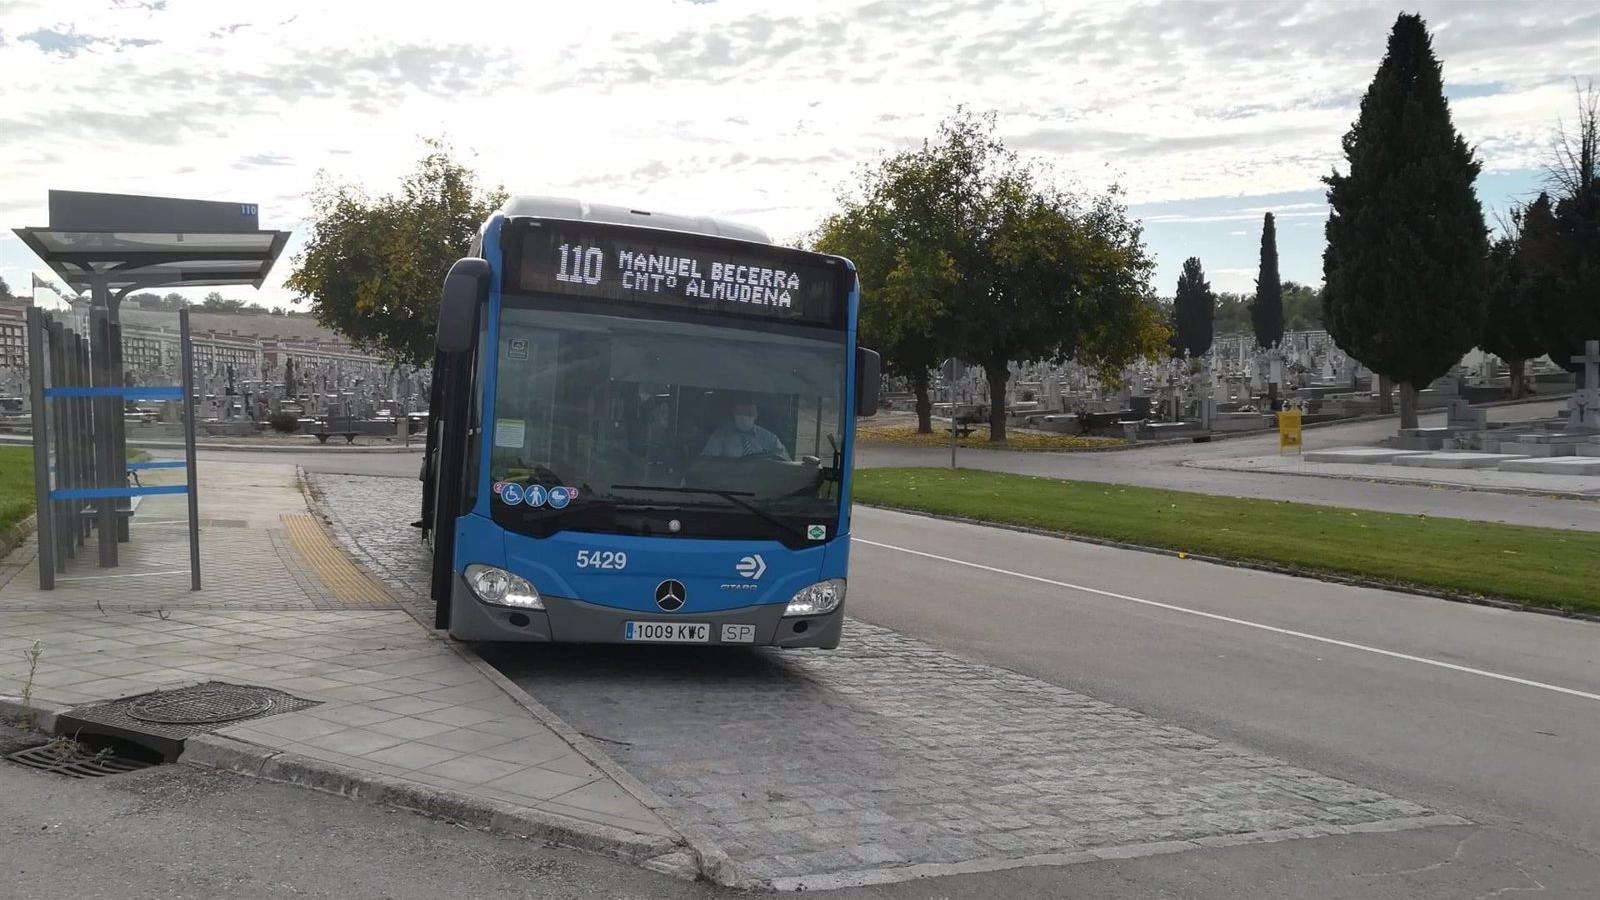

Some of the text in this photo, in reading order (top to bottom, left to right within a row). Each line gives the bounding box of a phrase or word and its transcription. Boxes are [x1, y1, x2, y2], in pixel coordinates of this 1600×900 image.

[240, 205, 257, 216] 110
[556, 243, 604, 285] 110
[619, 250, 801, 290] MANUEL BECERRA
[685, 278, 792, 308] ALMUDENA
[576, 550, 627, 570] 5429
[638, 624, 674, 639] 1009
[678, 625, 706, 640] KWC
[726, 626, 751, 641] SP
